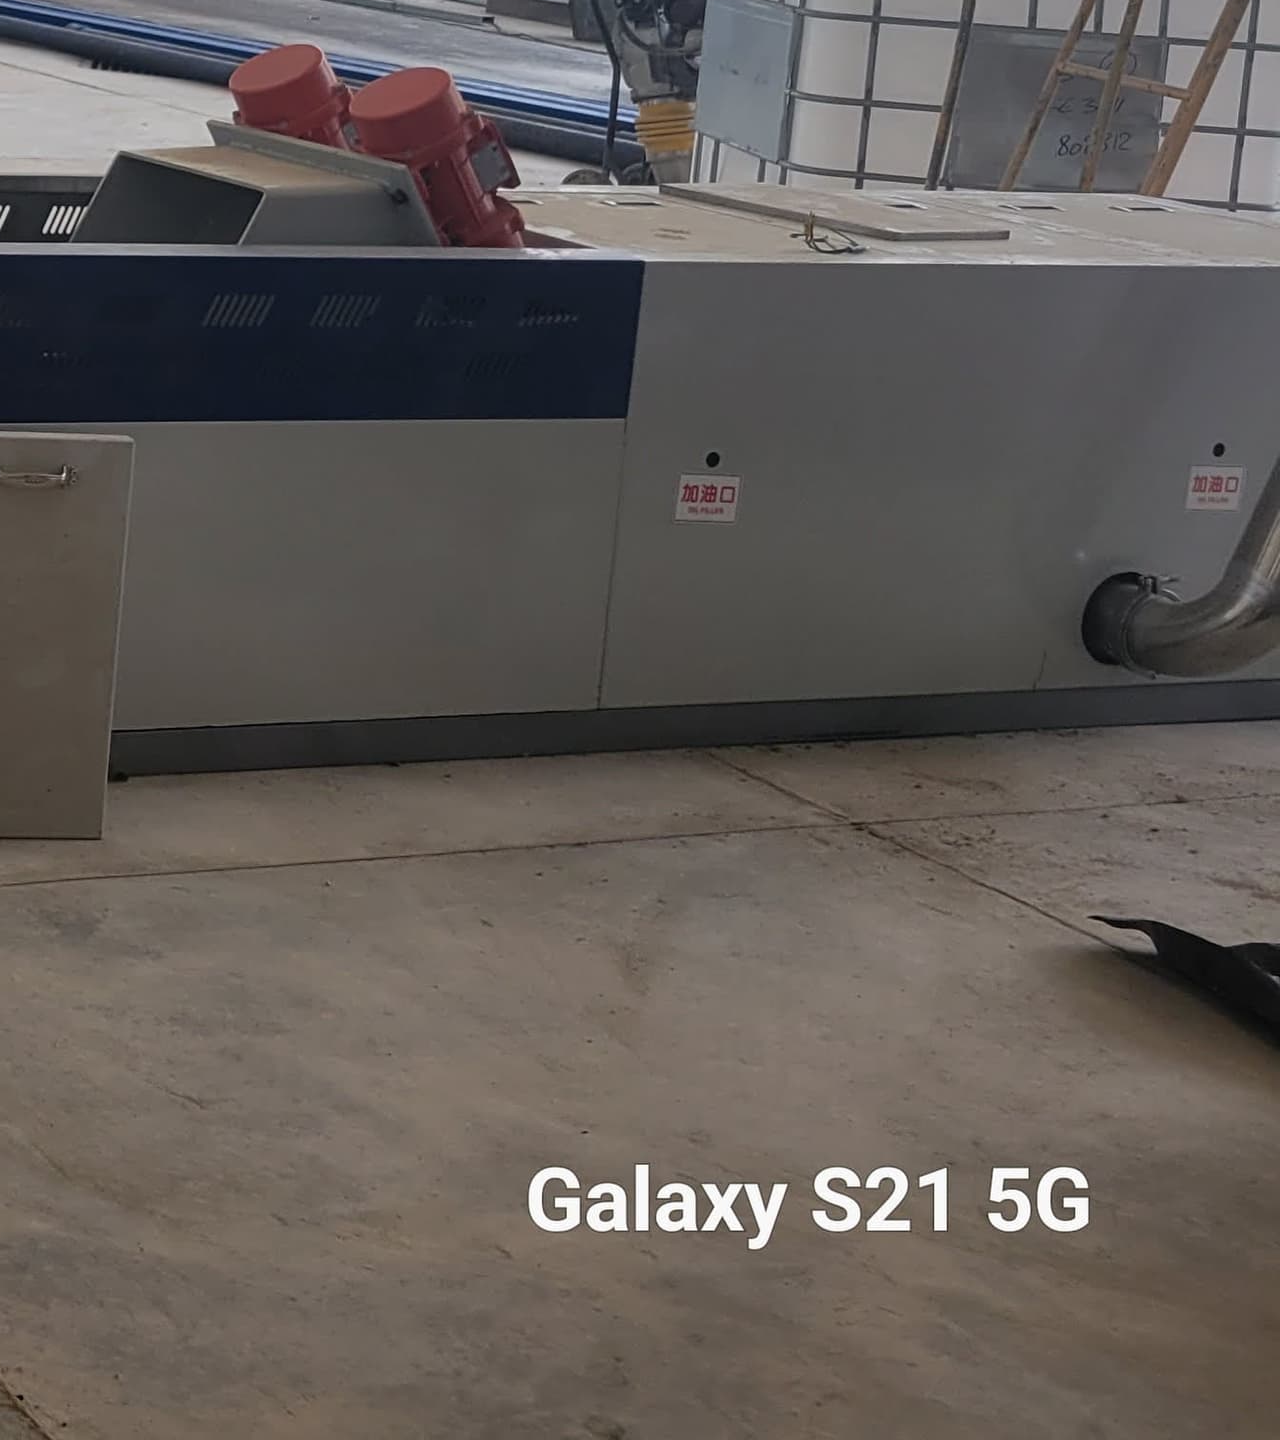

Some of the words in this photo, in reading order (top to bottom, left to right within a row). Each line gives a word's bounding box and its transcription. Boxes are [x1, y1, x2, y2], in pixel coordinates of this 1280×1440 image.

[680, 483, 736, 503] 加油口
[1191, 475, 1240, 493] 加油口
